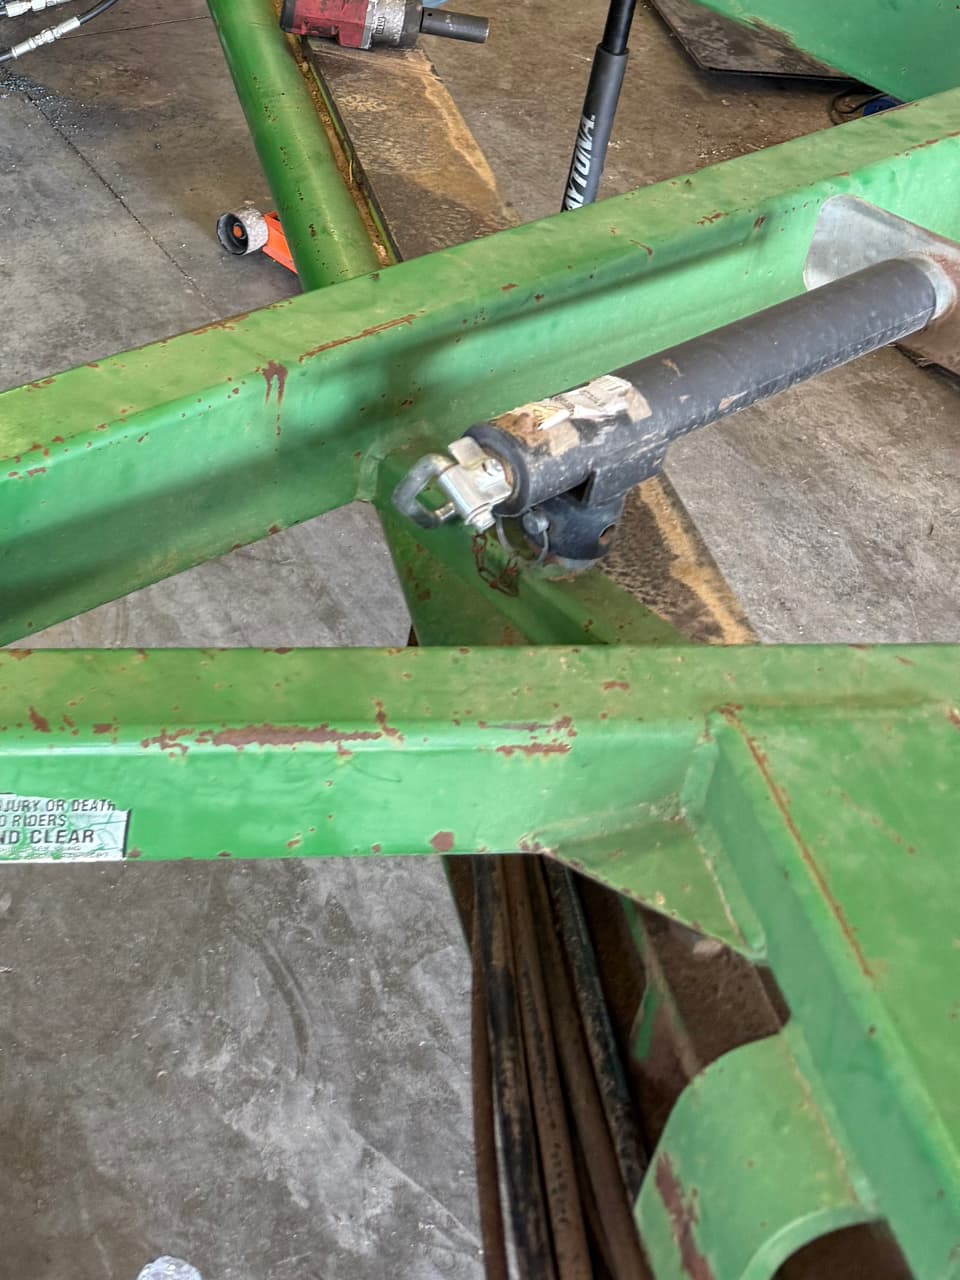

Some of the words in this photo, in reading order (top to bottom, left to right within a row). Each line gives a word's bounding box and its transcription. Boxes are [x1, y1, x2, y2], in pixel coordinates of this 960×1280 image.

[45, 799, 65, 812] OR
[12, 814, 67, 827] RIDERS
[29, 829, 95, 845] CLEAR
